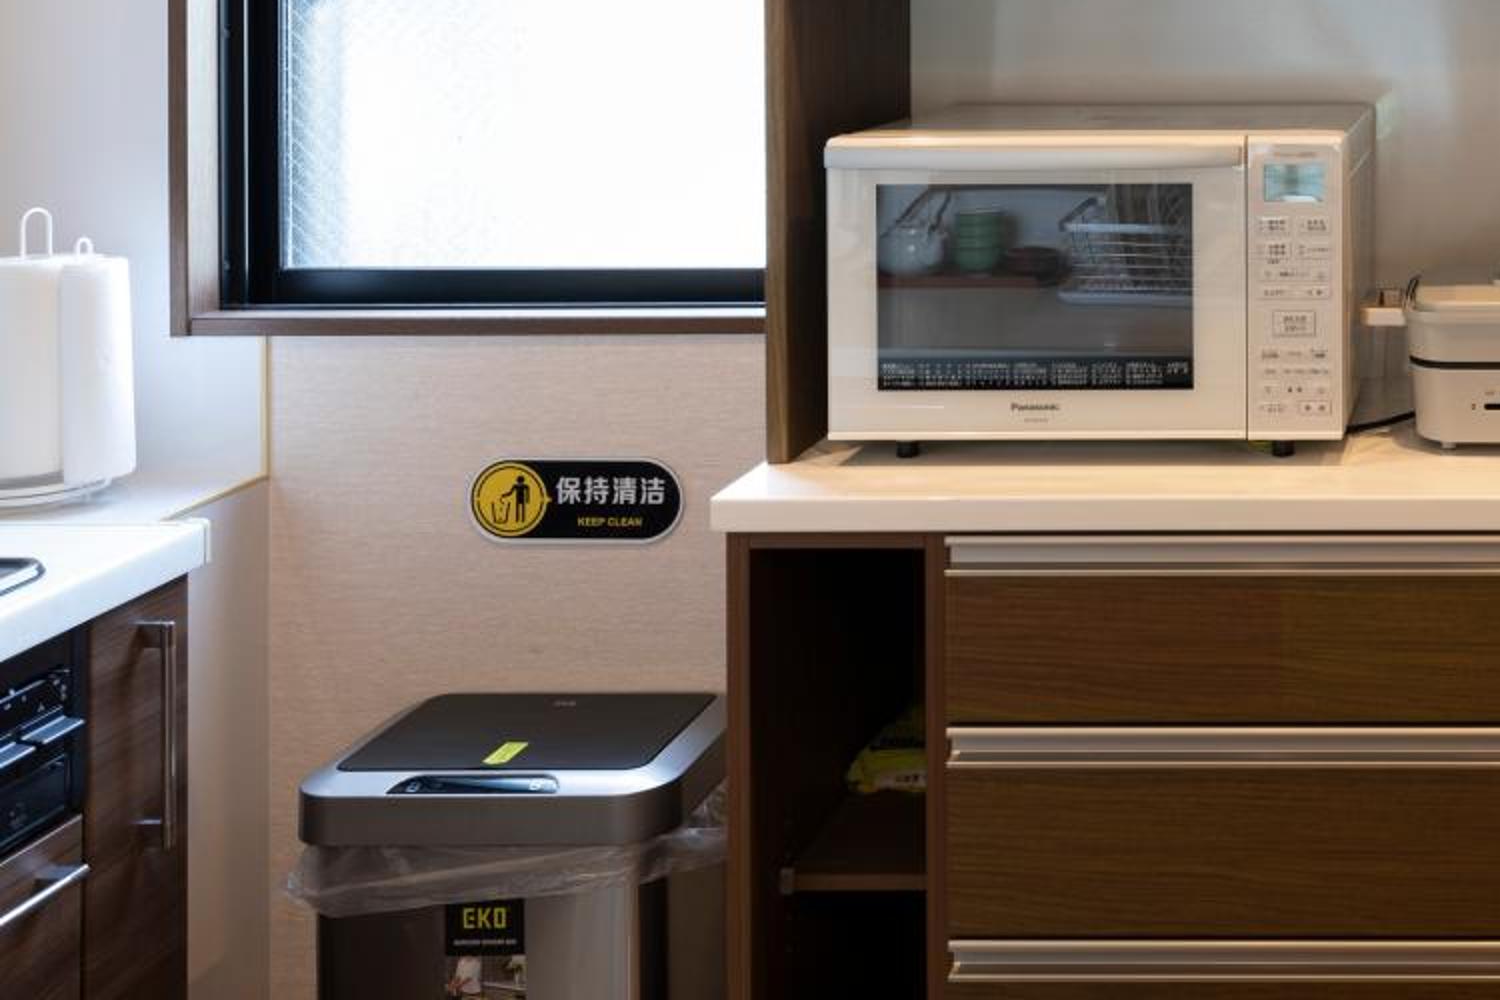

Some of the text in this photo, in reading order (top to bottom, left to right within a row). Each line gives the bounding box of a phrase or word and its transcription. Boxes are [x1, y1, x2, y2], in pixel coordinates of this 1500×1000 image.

[556, 476, 665, 505] 保持清洁
[577, 517, 642, 527] KEEP CLEAN
[463, 907, 507, 930] EKO
